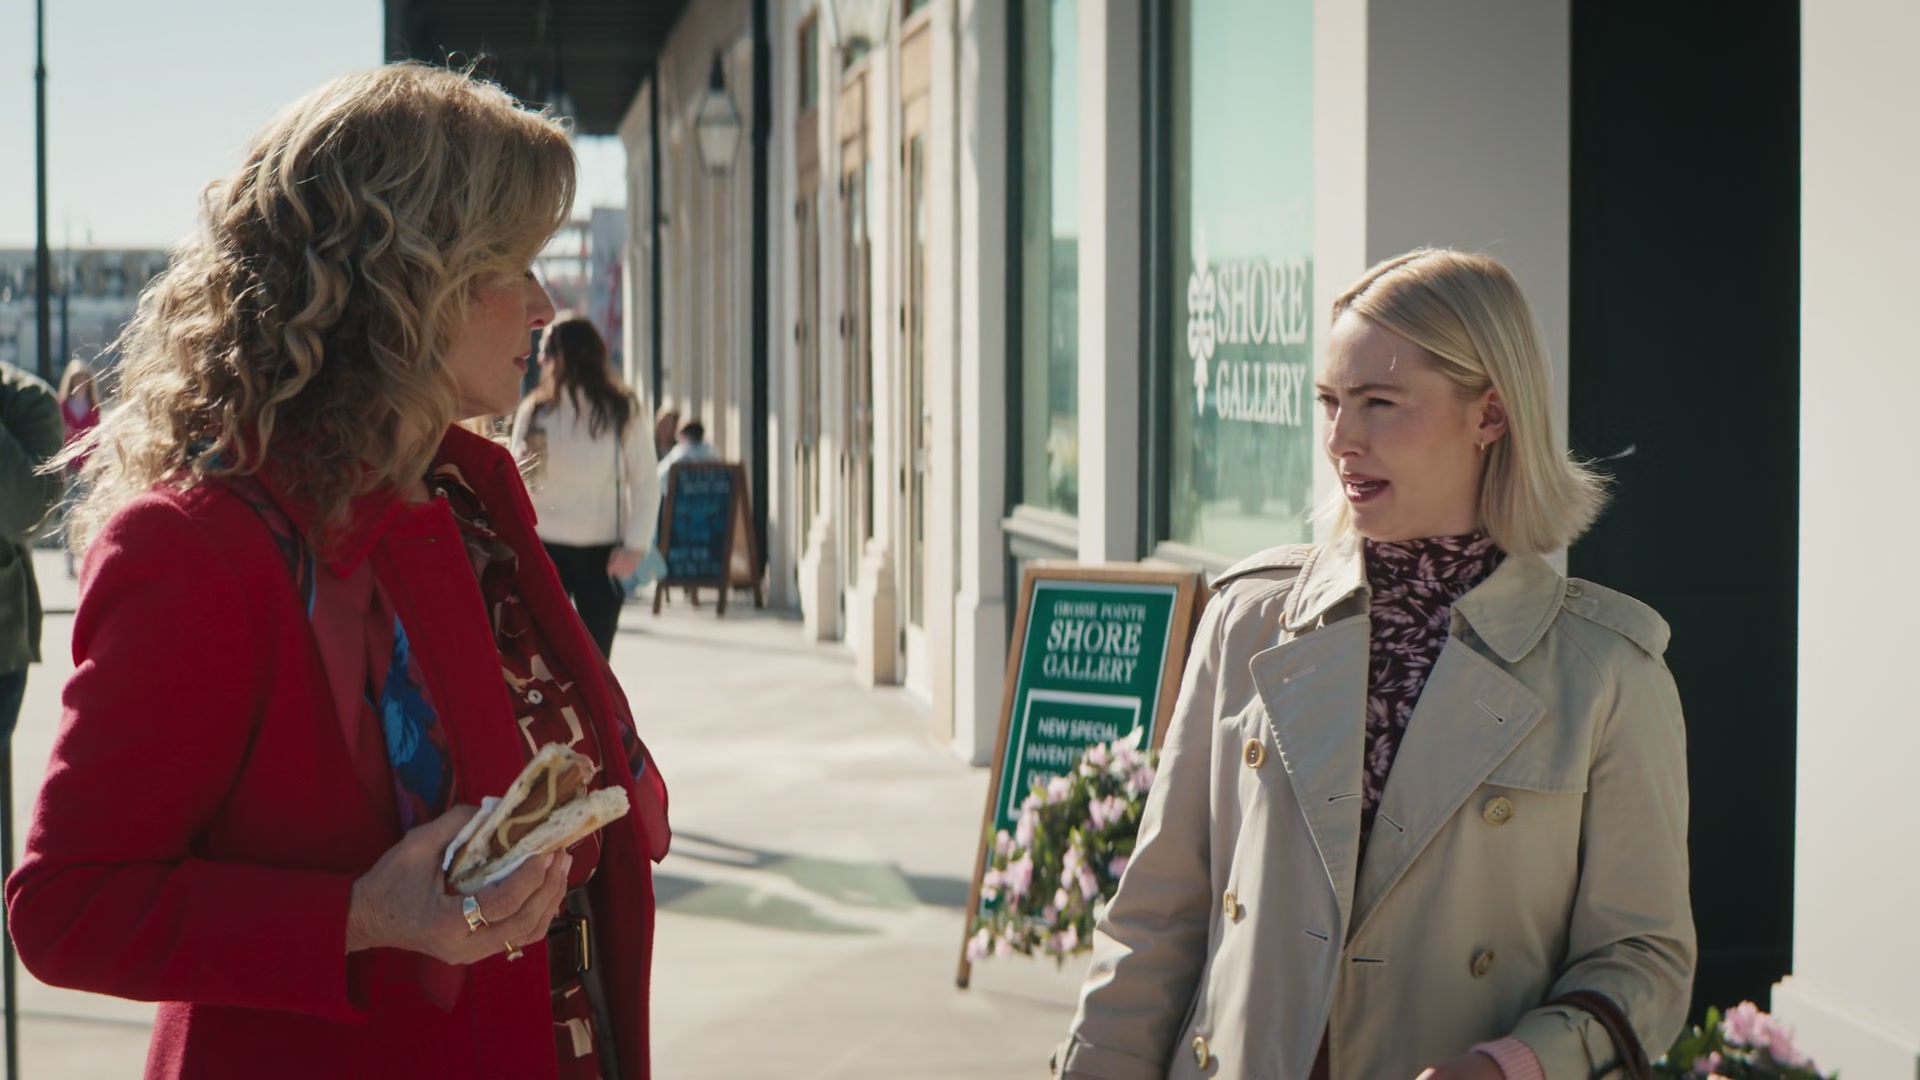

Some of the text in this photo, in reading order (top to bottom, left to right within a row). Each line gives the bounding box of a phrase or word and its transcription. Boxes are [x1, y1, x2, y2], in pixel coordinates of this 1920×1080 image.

[1216, 257, 1307, 345] SHORE
[1215, 360, 1306, 427] GALLERY
[1053, 600, 1146, 622] GROSSE POINTE
[1047, 619, 1141, 656] SHORE
[1043, 653, 1137, 684] GALLERY
[1038, 716, 1118, 742] NEW SPECIAL
[1026, 742, 1084, 767] INVENT
